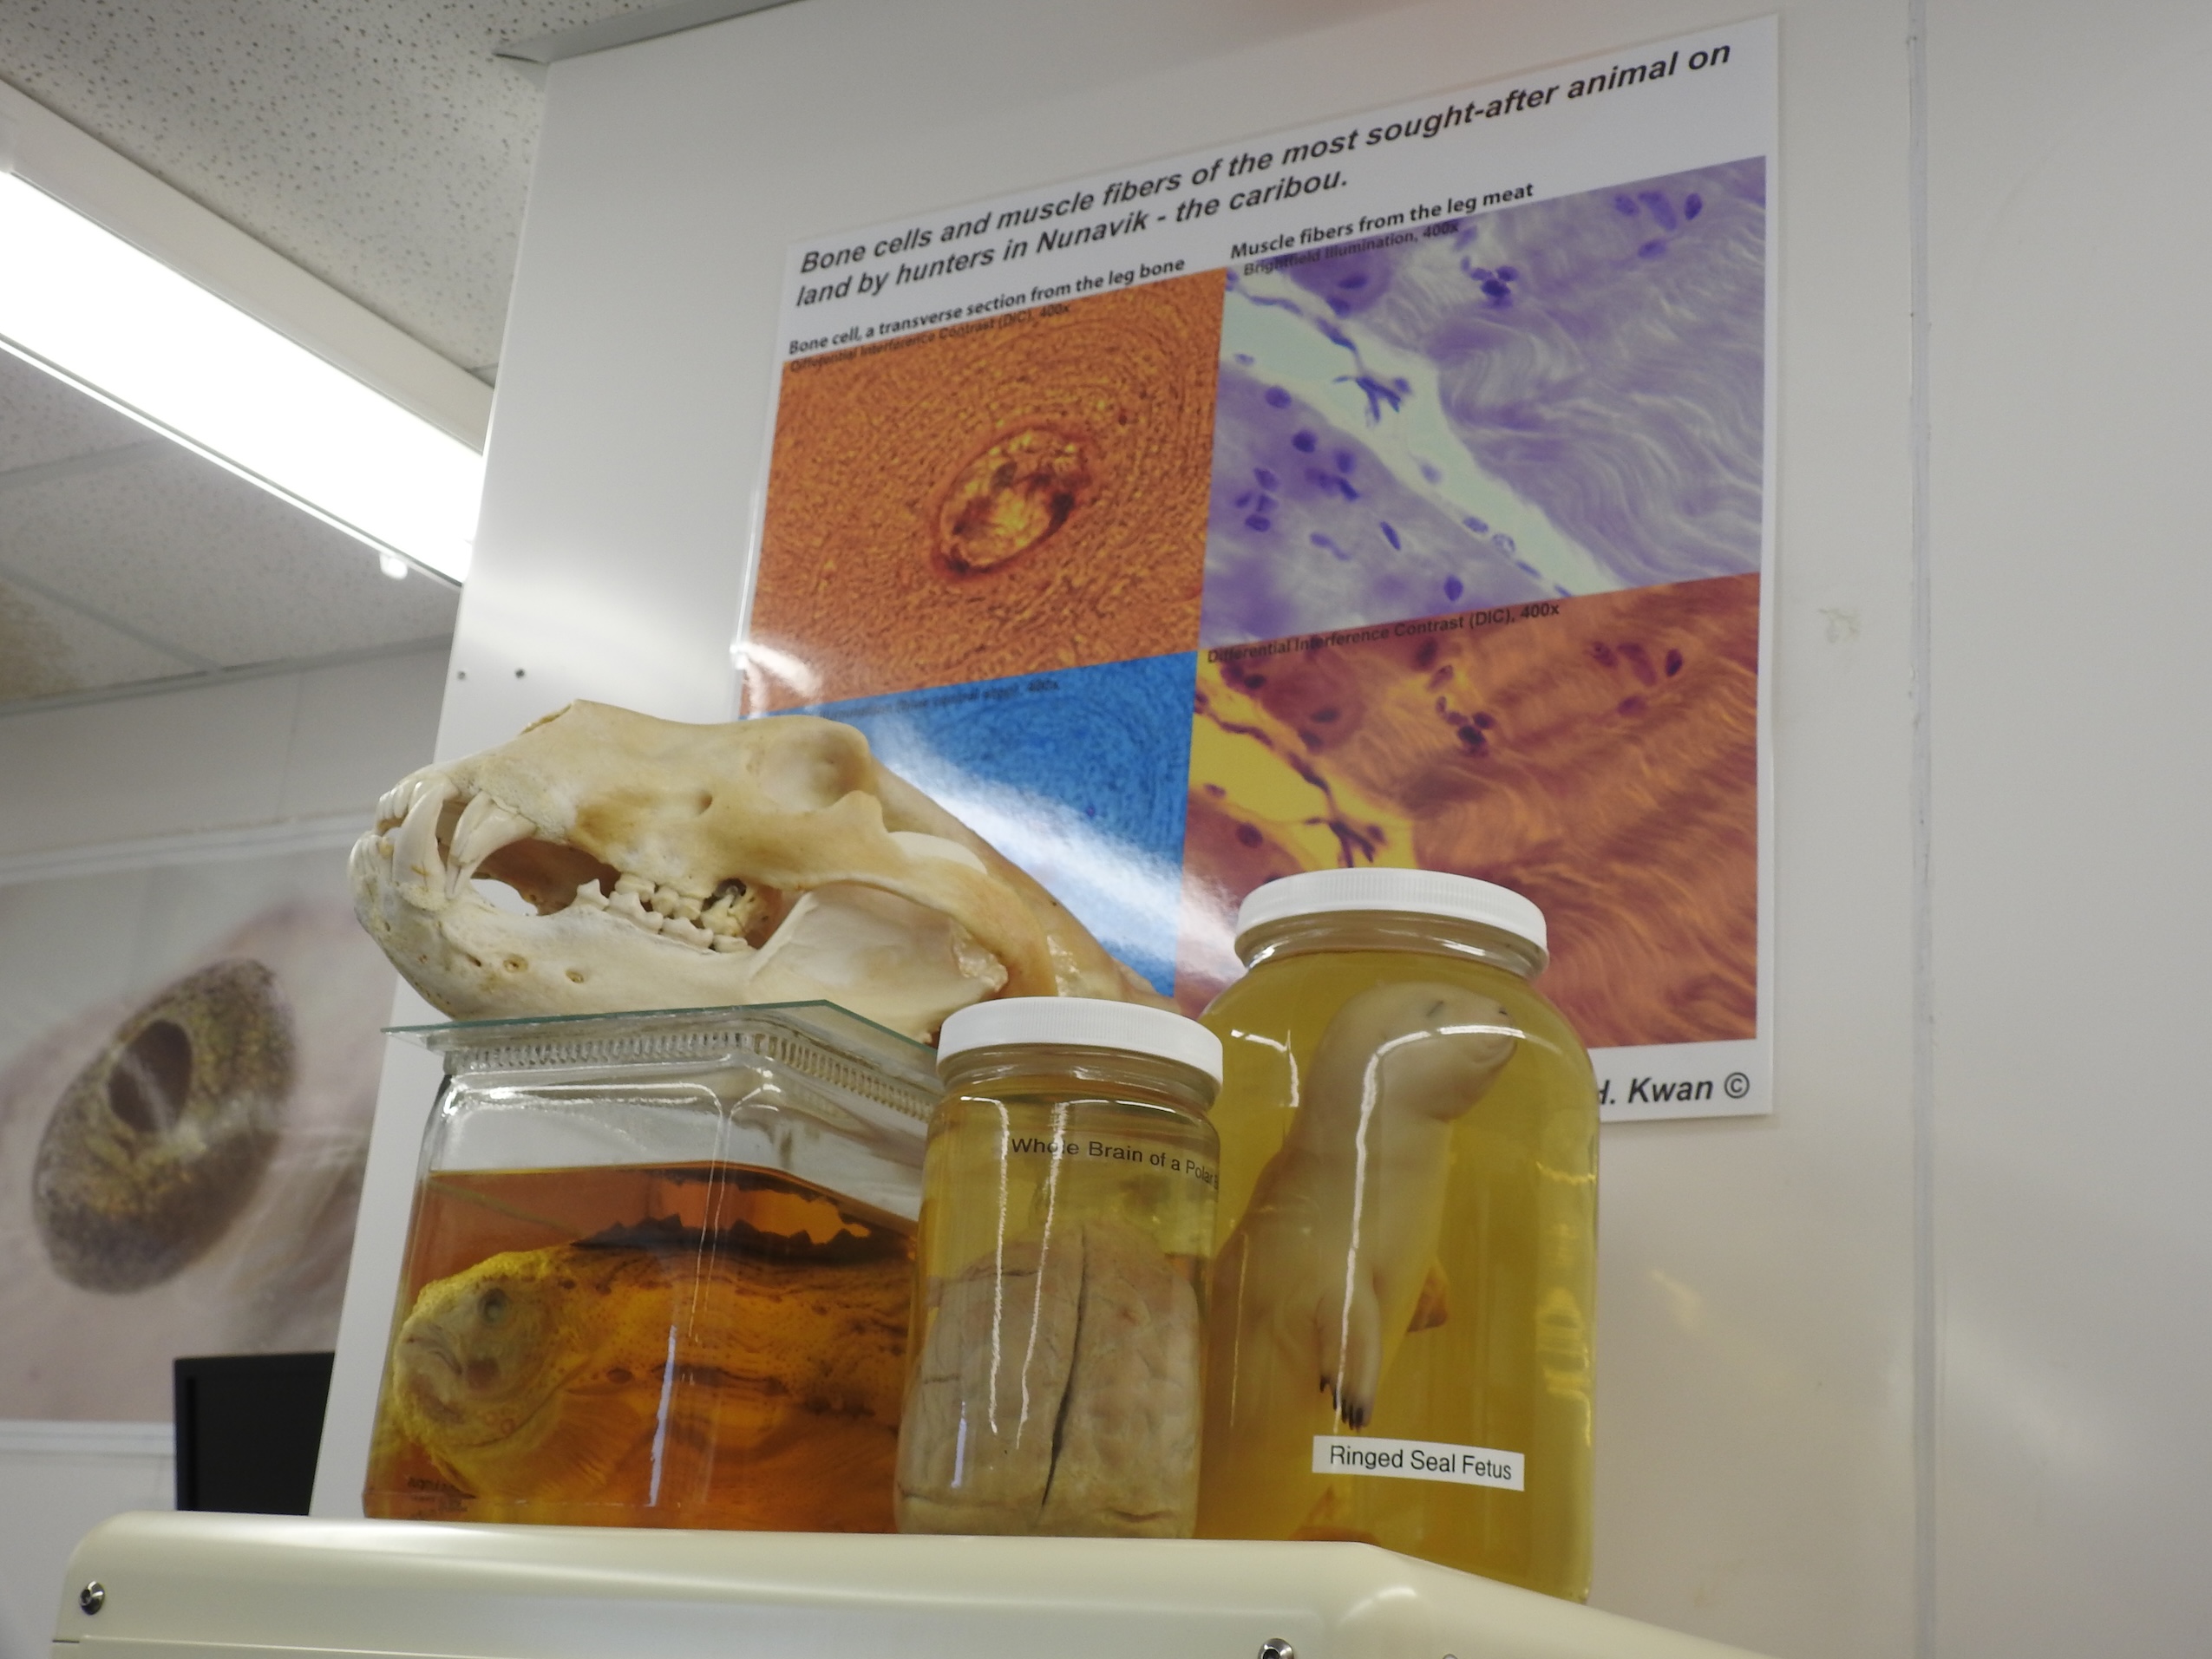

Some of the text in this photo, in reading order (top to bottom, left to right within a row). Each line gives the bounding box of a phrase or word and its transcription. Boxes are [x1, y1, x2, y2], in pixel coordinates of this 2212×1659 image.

[800, 45, 1731, 273] Bone cells and muscle fibers of the most sought-after animal on
[795, 275, 853, 307] land
[857, 272, 889, 296] by
[895, 247, 996, 285] hunters
[1003, 239, 1028, 261] in
[1037, 210, 1150, 253] Nunavik
[1175, 198, 1220, 223] the
[1229, 171, 1347, 211] caribou.
[1230, 183, 1534, 259] Muscle fibers from the leg meat
[1423, 220, 1459, 238] 400x
[789, 259, 1186, 355] Bone cell, a transverse section from the leg bone
[1207, 639, 1291, 663] Differential
[1394, 617, 1464, 637] Contrast
[1520, 603, 1561, 618] 400x
[1627, 1076, 1714, 1104] Kwan
[1011, 1138, 1080, 1155] Whole
[1089, 1140, 1142, 1163] Brain
[1149, 1152, 1168, 1167] of
[1171, 1159, 1181, 1172] a
[1186, 1159, 1213, 1185] Polar
[1330, 1445, 1512, 1480] Ringed Seal Fetus
